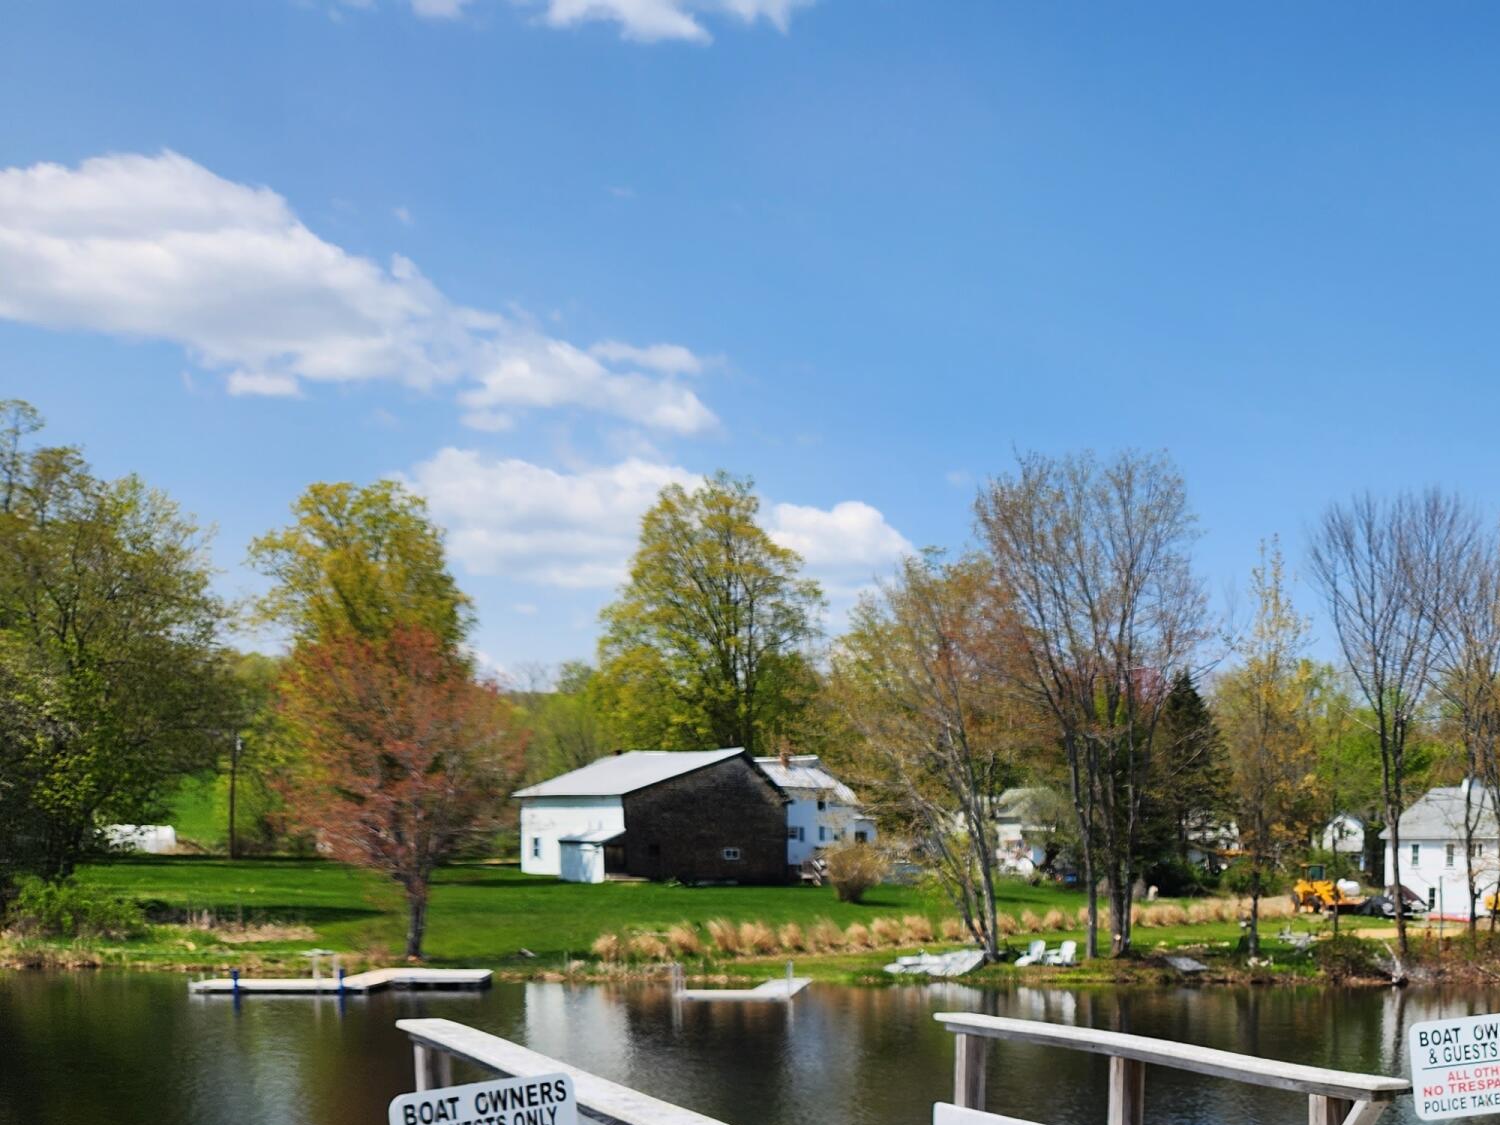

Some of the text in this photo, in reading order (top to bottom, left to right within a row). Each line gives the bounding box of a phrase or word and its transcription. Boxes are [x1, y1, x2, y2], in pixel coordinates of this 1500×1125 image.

[1419, 1027, 1461, 1047] BOAT
[1429, 1048, 1438, 1065] &
[1443, 1041, 1498, 1063] GUESTS
[1447, 1069, 1470, 1082] ALL
[475, 1080, 567, 1115] OWNERS
[1423, 1085, 1444, 1098] NO
[1424, 1097, 1467, 1114] POLICE
[1472, 1093, 1500, 1107] TAKE
